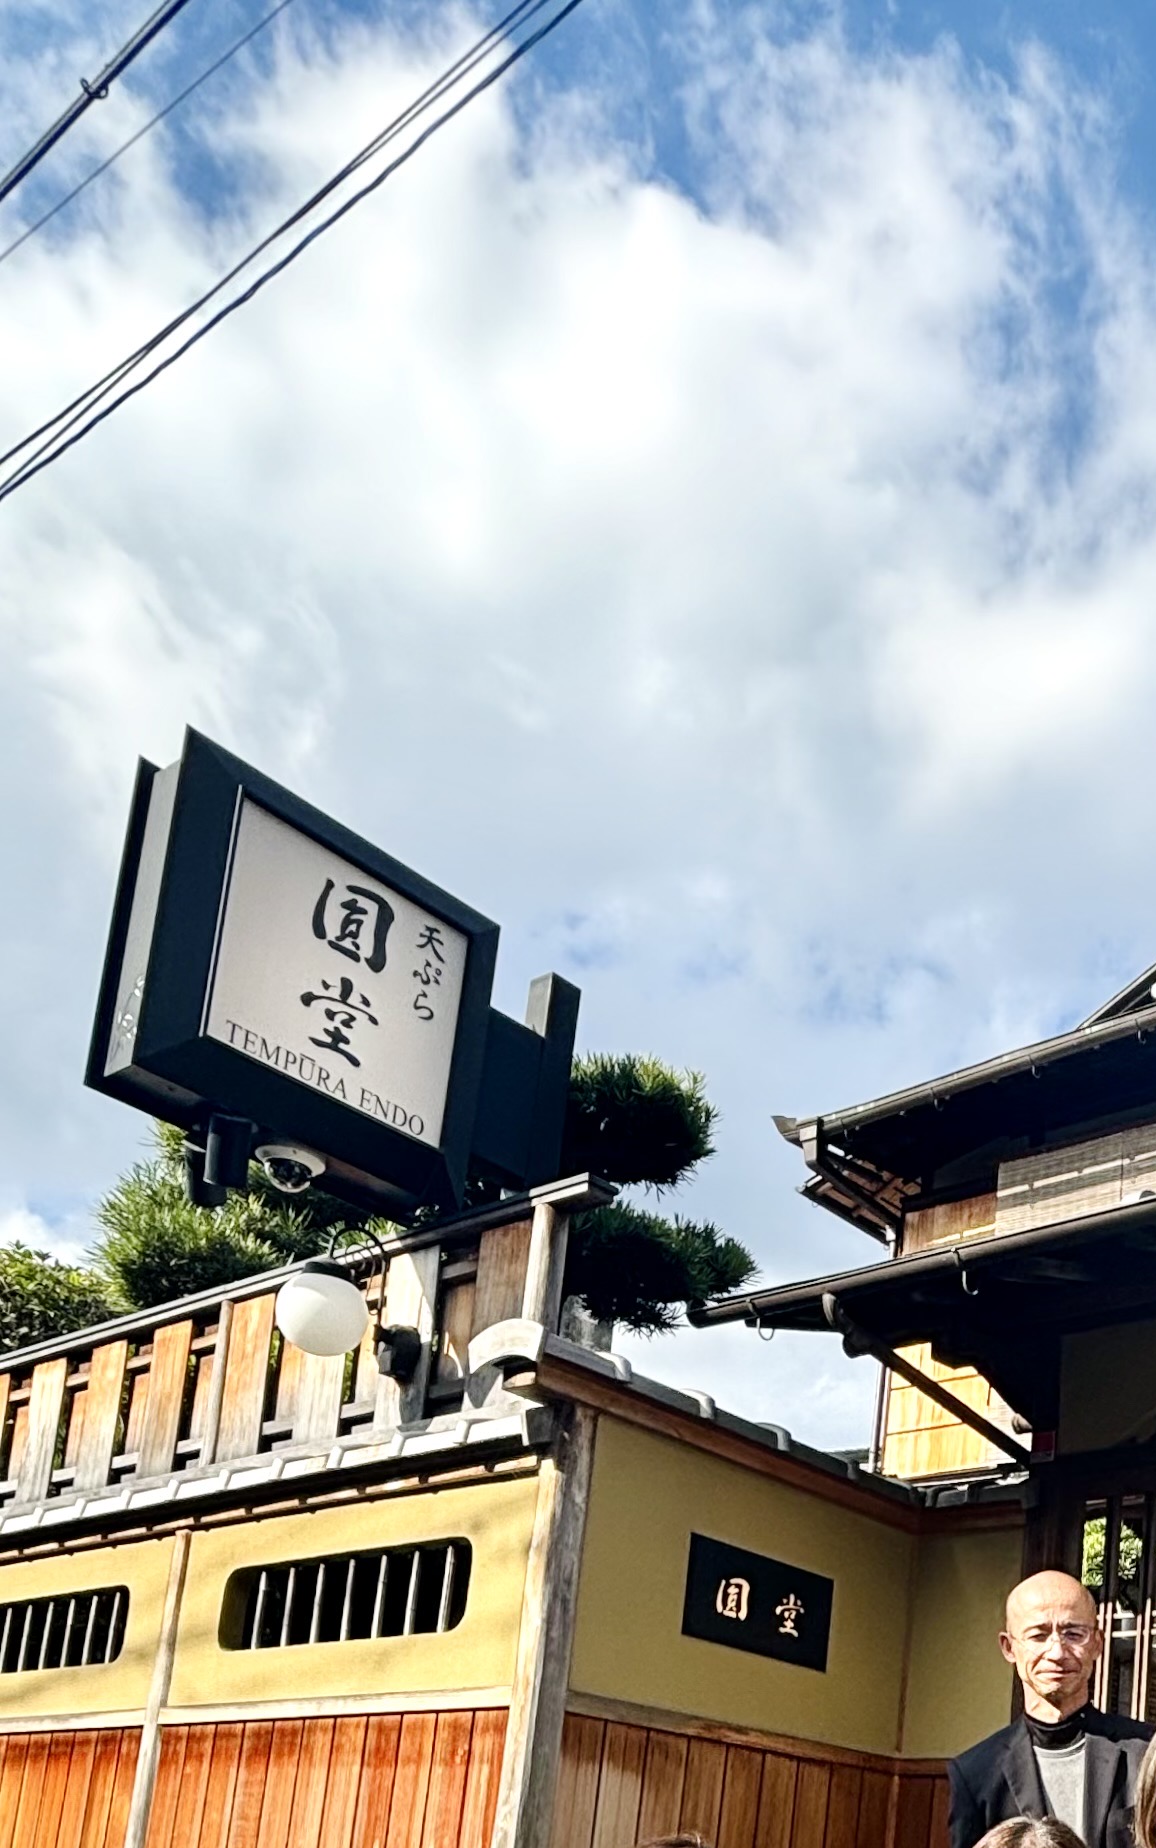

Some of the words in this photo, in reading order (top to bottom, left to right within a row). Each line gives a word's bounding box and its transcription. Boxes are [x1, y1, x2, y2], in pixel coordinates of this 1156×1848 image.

[413, 924, 445, 1020] 天ぷら
[359, 1087, 424, 1136] ENDO
